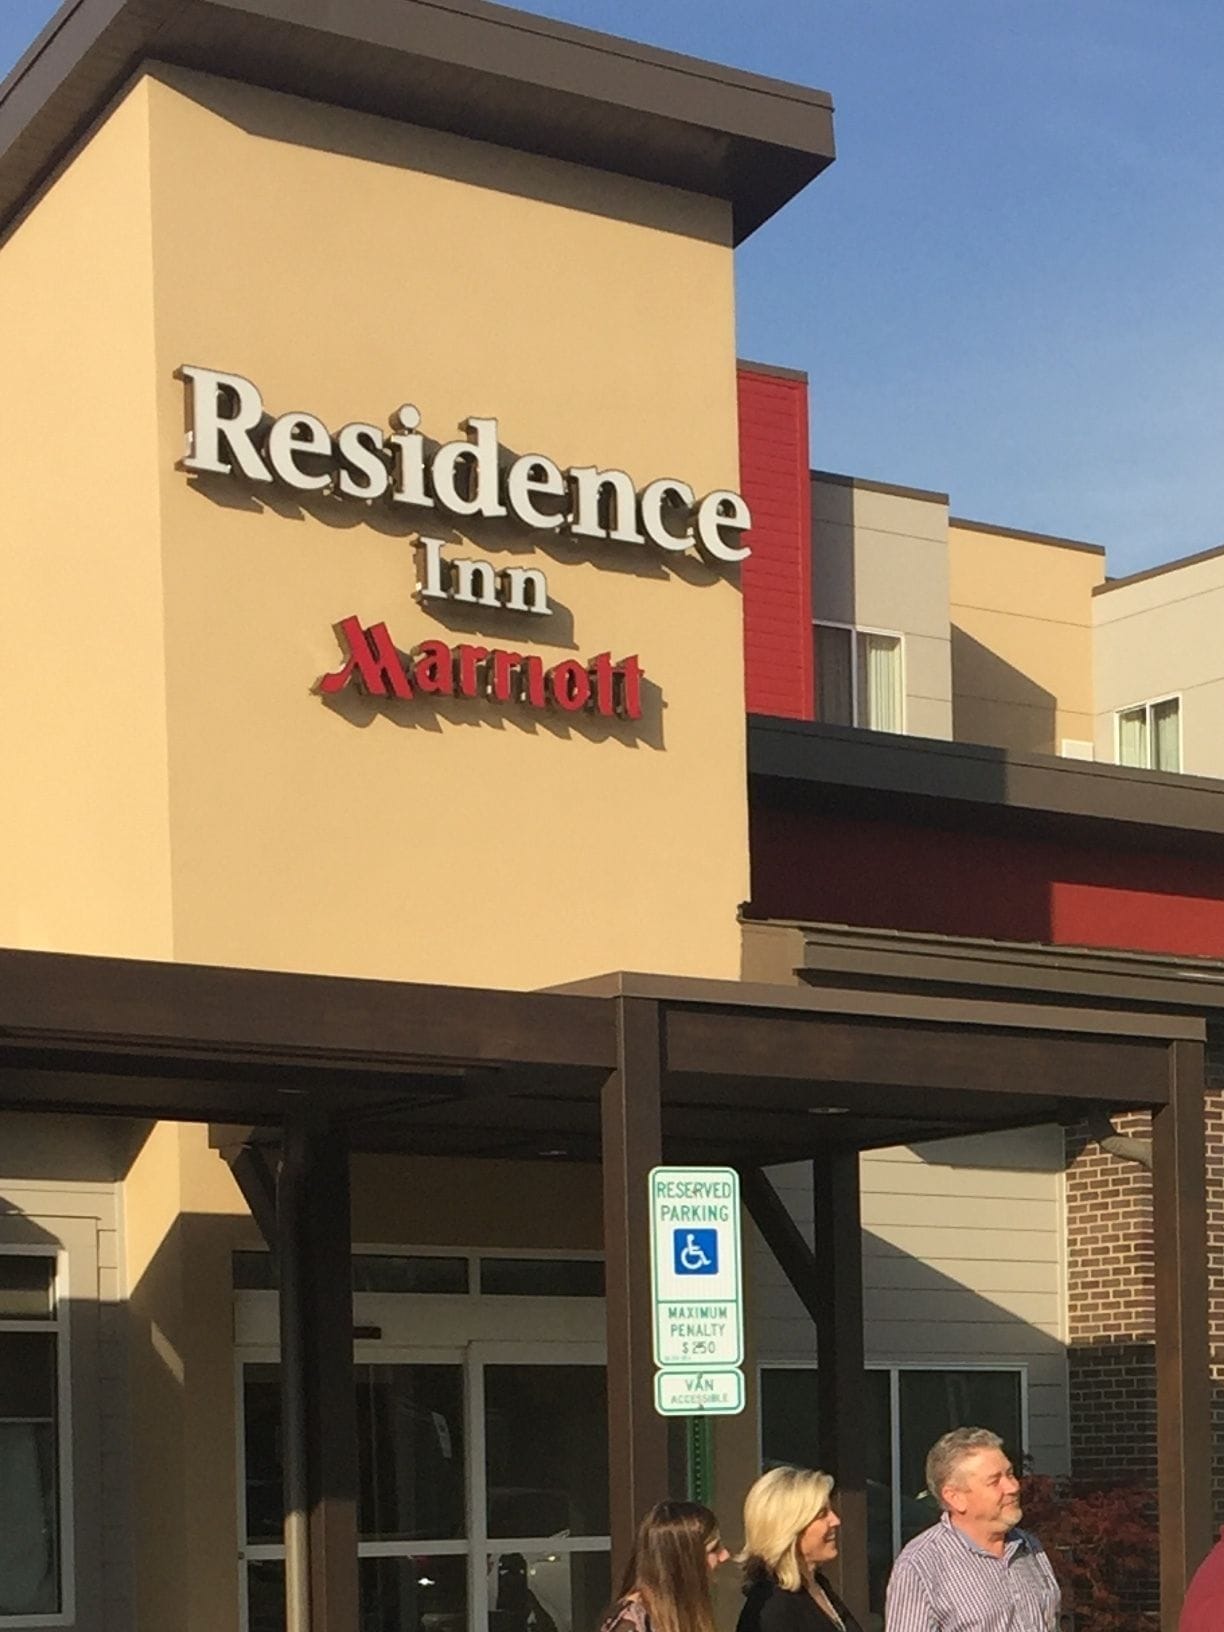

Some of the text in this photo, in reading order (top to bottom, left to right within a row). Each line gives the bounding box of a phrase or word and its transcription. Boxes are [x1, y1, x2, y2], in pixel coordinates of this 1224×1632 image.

[174, 365, 753, 561] Residence
[412, 534, 553, 615] Inn
[313, 615, 644, 720] Marriott
[657, 1181, 731, 1199] RESERVED
[660, 1205, 729, 1222] PARKING
[668, 1306, 728, 1319] MAXIMUM
[670, 1323, 726, 1337] PENALTY
[682, 1341, 716, 1354] $250
[685, 1379, 714, 1391] VAN
[670, 1393, 728, 1404] ACCESSIBLE
